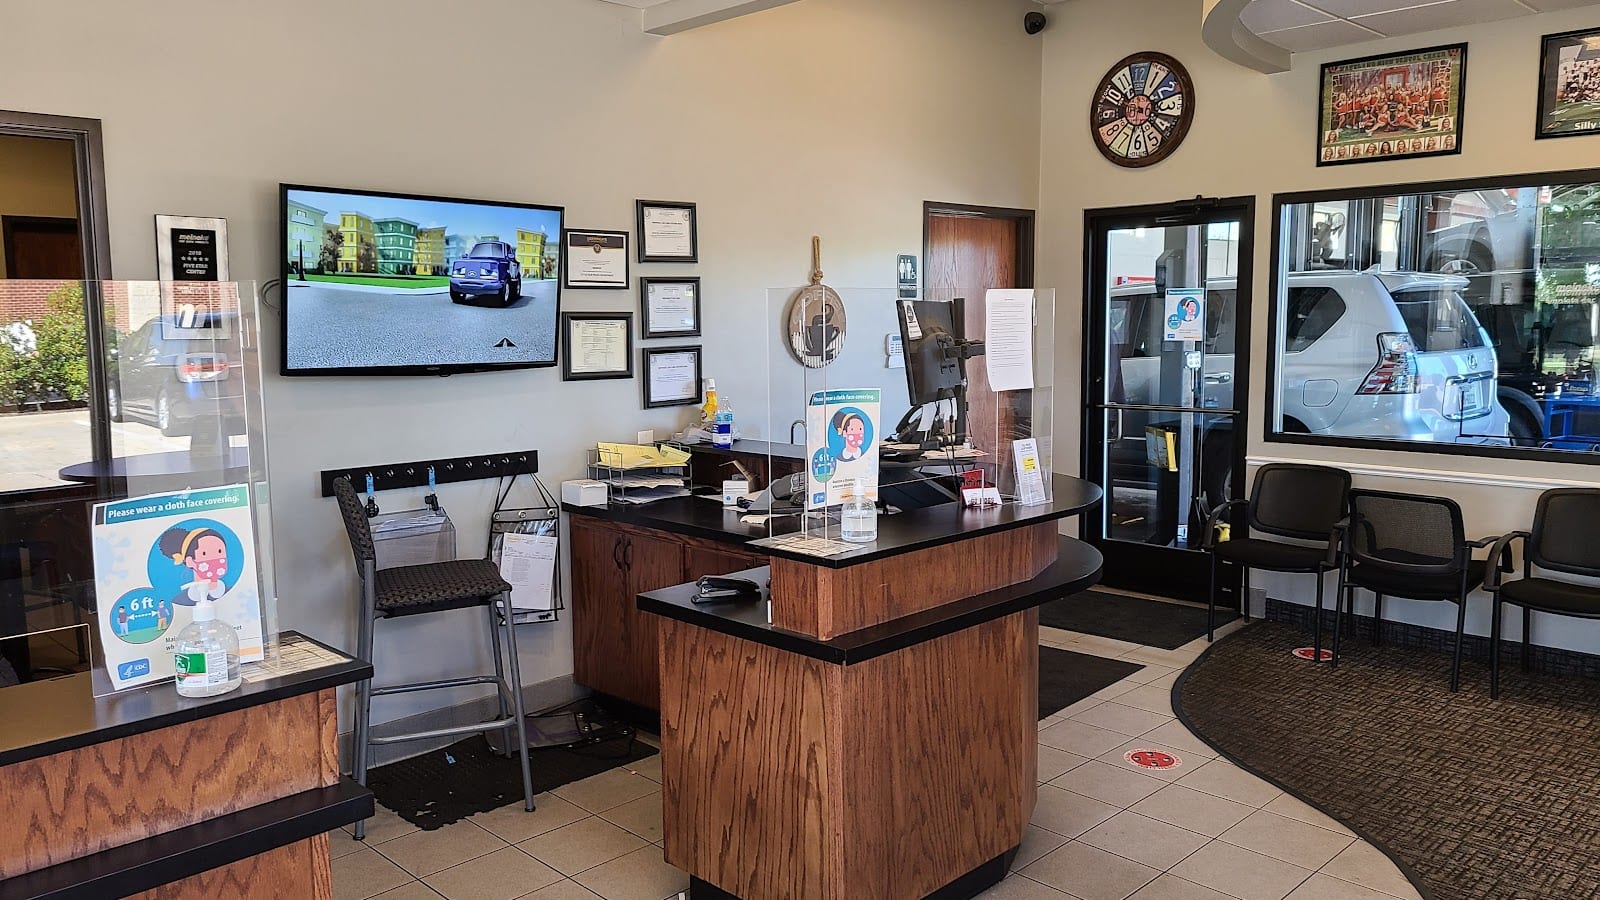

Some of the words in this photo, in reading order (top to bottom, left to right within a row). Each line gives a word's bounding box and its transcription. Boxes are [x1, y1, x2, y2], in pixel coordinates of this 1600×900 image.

[1106, 89, 1121, 105] 10
[1157, 81, 1176, 99] 2
[1159, 101, 1175, 111] 3
[1106, 124, 1120, 136] 8
[1574, 121, 1597, 130] Silly
[1117, 131, 1130, 149] 7
[1134, 134, 1142, 150] 6
[1147, 131, 1159, 146] 5
[108, 508, 135, 519] Please
[136, 504, 156, 513] wear
[165, 500, 185, 510] cloth
[187, 499, 203, 508] face
[130, 598, 140, 611] 6
[141, 596, 154, 609] ft
[135, 663, 147, 671] CDC
